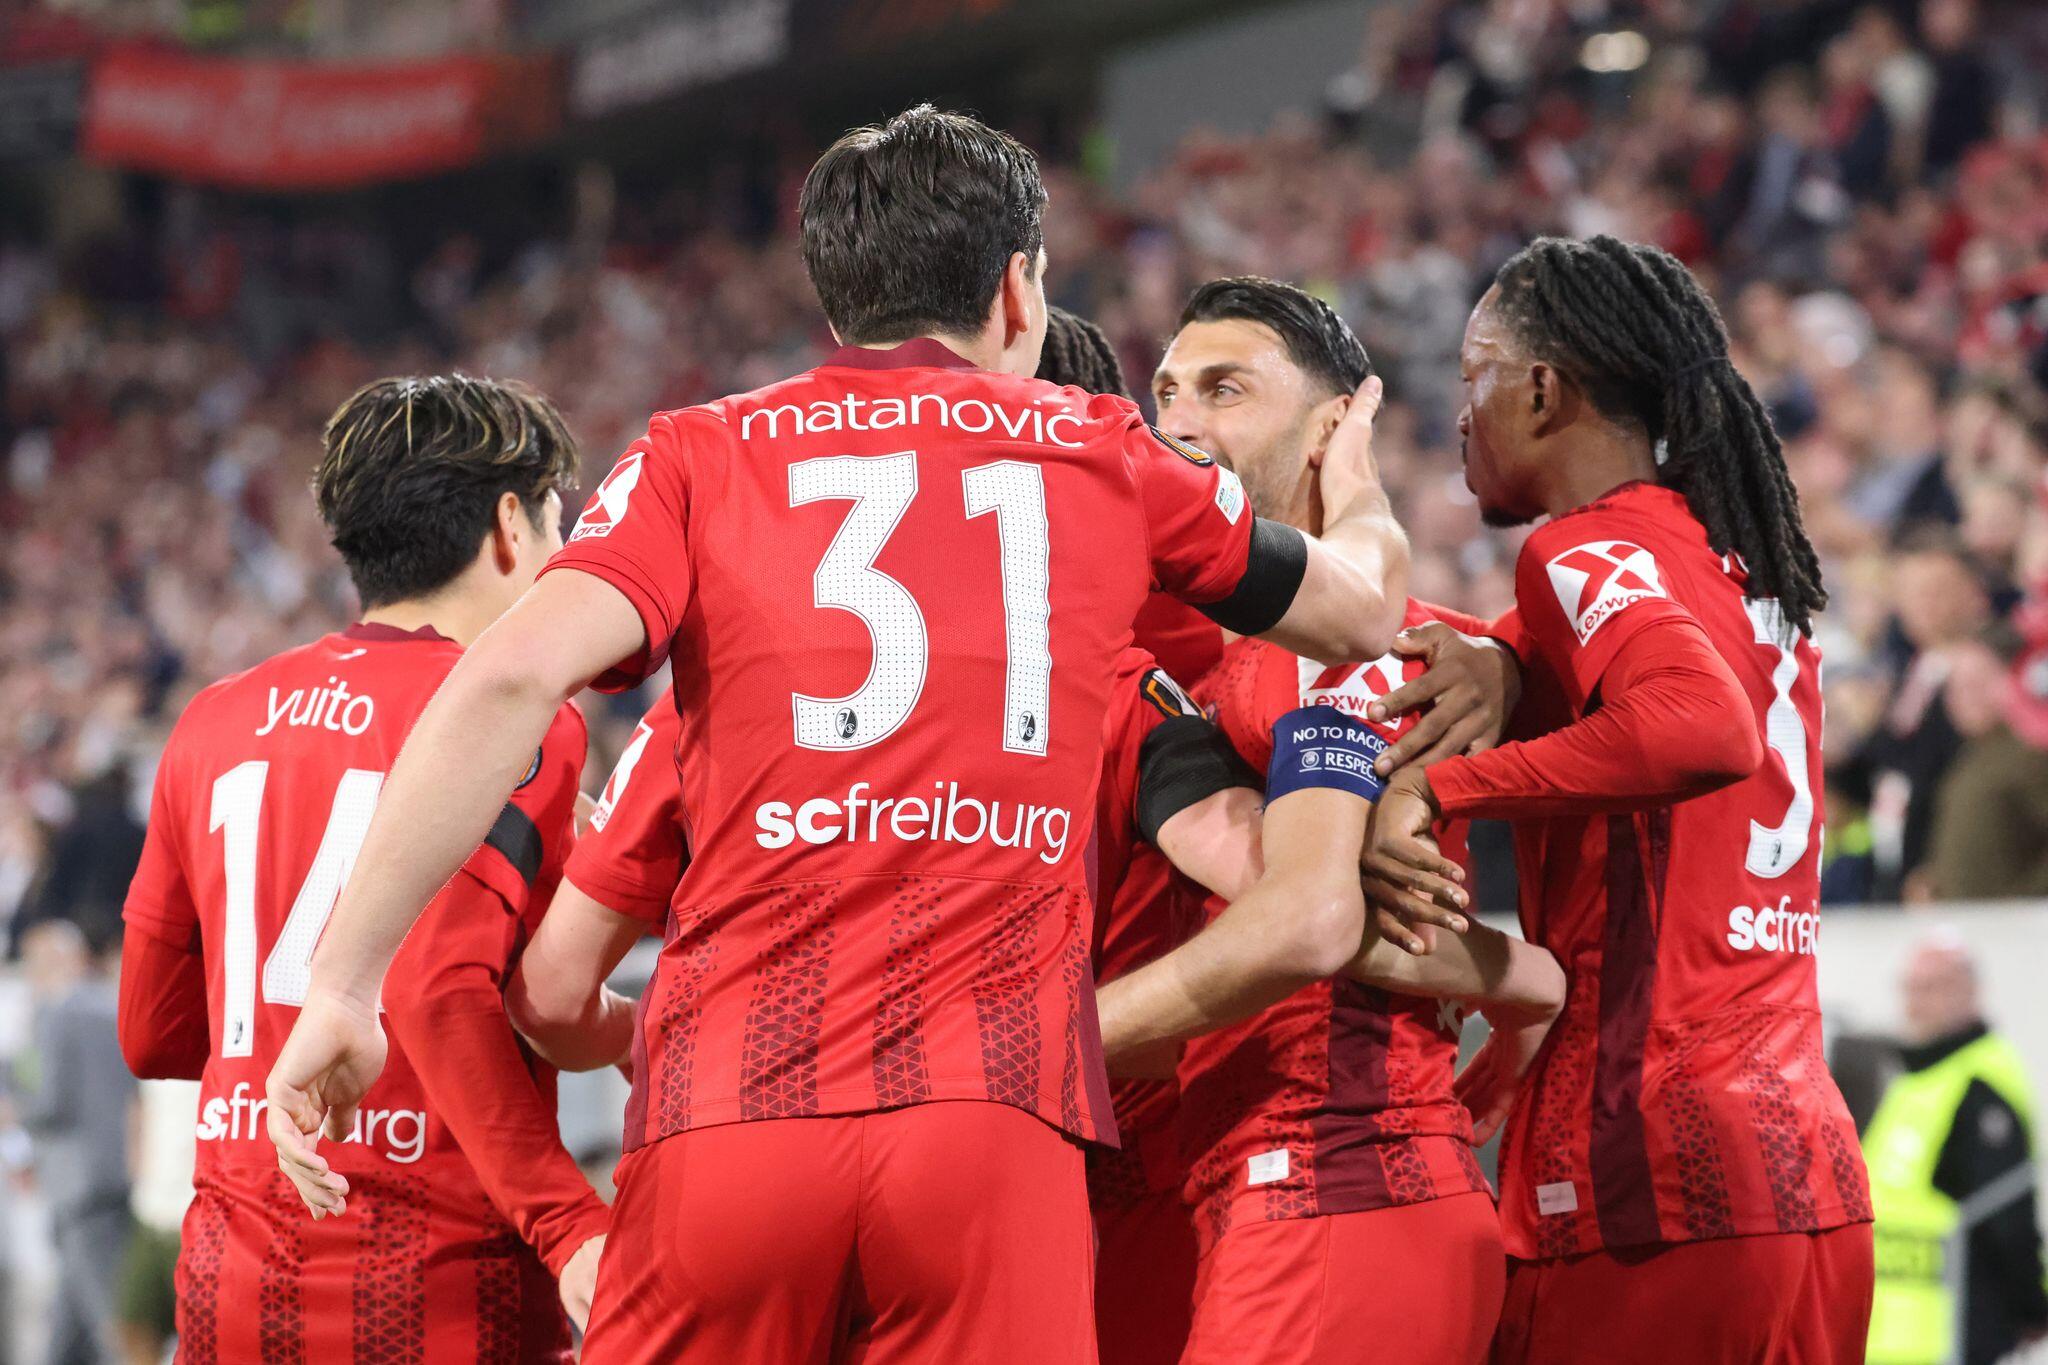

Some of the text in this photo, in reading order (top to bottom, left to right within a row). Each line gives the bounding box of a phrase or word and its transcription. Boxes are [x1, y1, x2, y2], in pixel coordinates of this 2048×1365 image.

[741, 392, 1085, 448] matanović
[787, 449, 1053, 757] 31
[254, 675, 375, 737] yuito
[1293, 727, 1318, 744] NO
[1320, 726, 1344, 739] TO
[1741, 594, 1825, 879] 3
[1325, 751, 1377, 782] RESPEC
[754, 781, 1071, 865] scfreiburg
